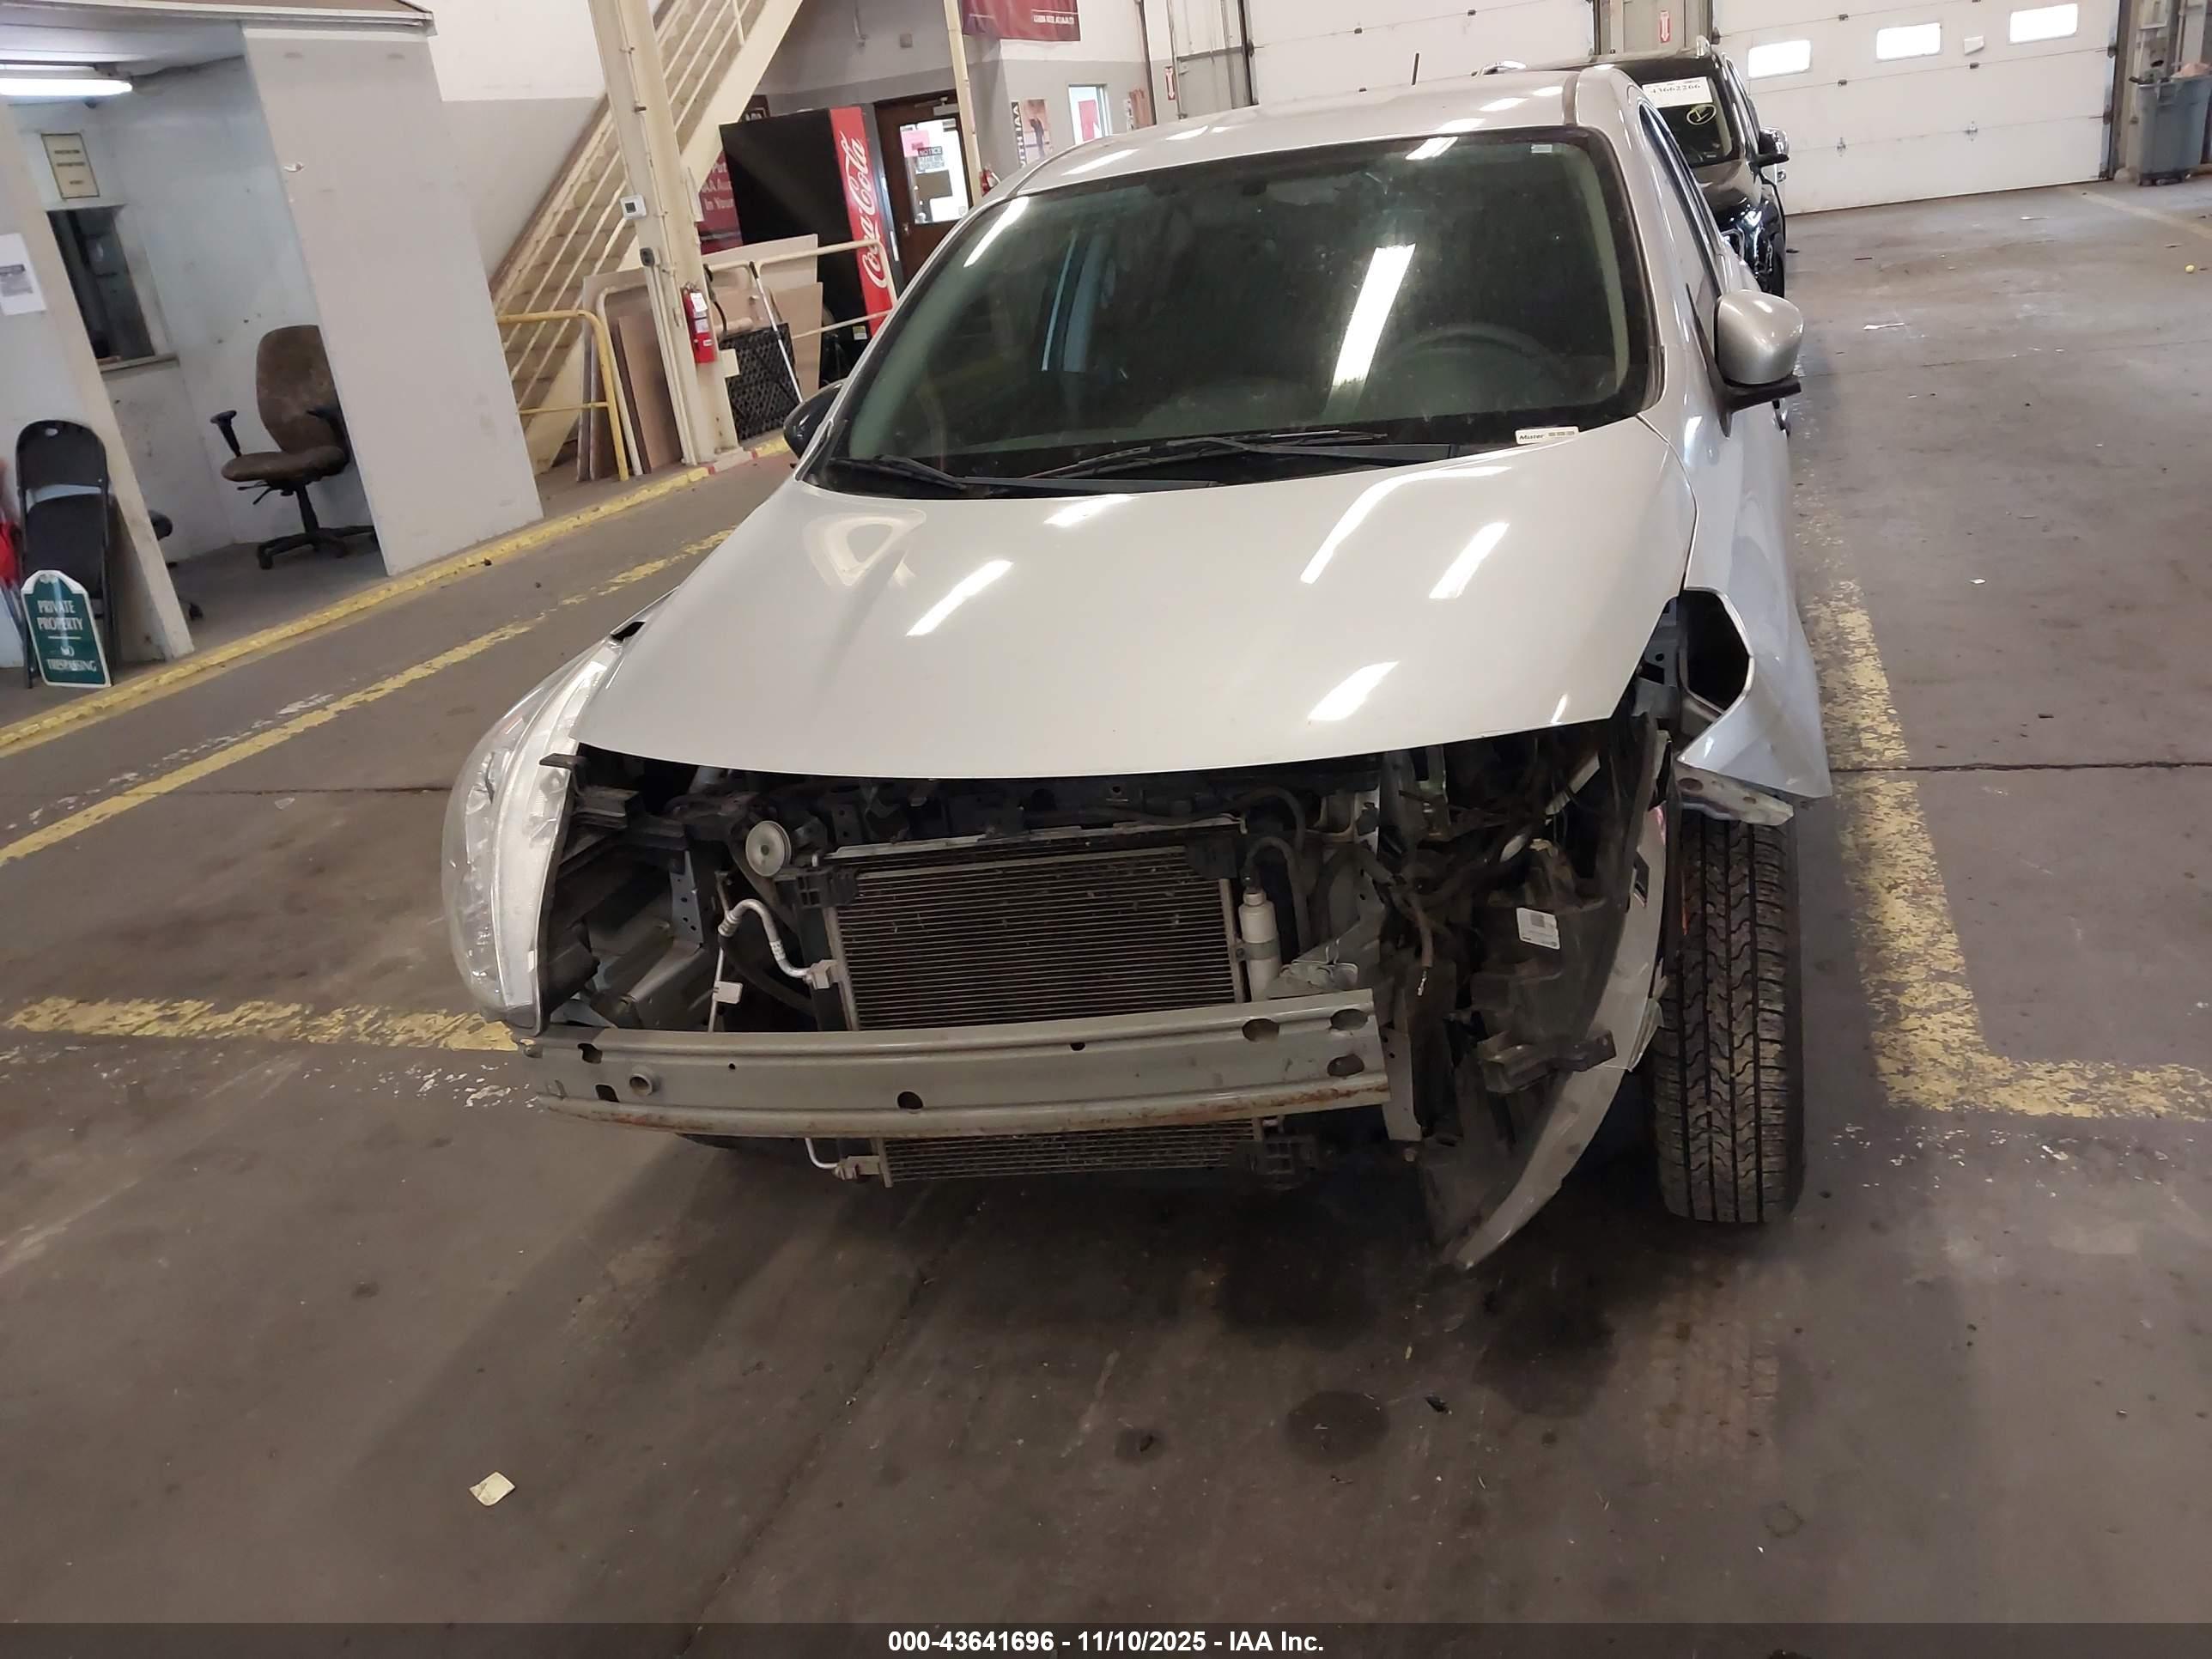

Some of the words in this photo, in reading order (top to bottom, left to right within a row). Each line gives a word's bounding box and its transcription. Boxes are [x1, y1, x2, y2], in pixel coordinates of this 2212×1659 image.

[37, 600, 76, 613] PRIVATE
[37, 617, 83, 630] PROPERTY
[60, 646, 75, 657] NO
